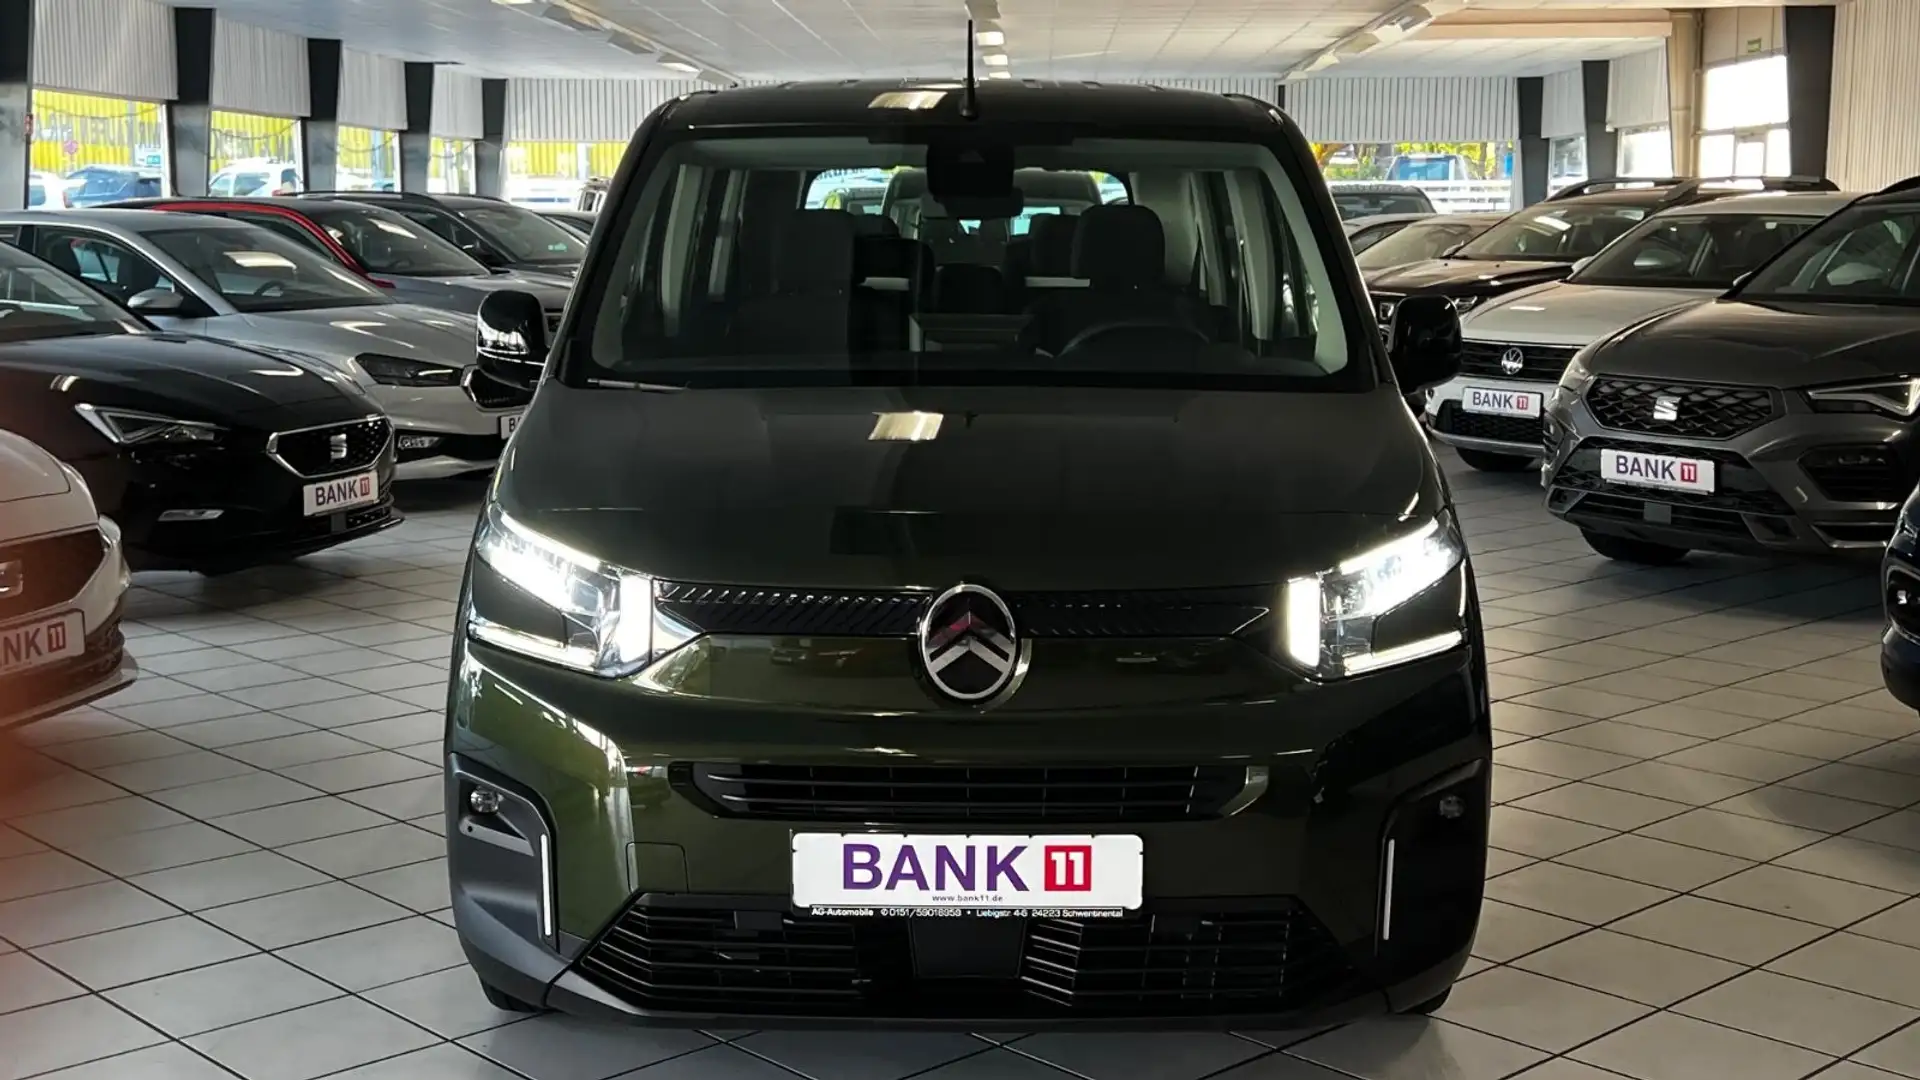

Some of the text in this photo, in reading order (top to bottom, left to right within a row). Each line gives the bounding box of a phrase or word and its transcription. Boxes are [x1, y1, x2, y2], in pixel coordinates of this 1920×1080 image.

[1473, 391, 1528, 410] BANK 11
[1616, 455, 1696, 482] BANK 11
[316, 478, 370, 506] BANK 11
[0, 624, 65, 665] NK 11
[842, 843, 1088, 892] BANK 11
[932, 894, 1003, 902] www.bank11.de
[811, 908, 874, 916] AG-Automobile
[1031, 909, 1061, 917] 24223
[1062, 909, 1123, 918] Schwentinental
